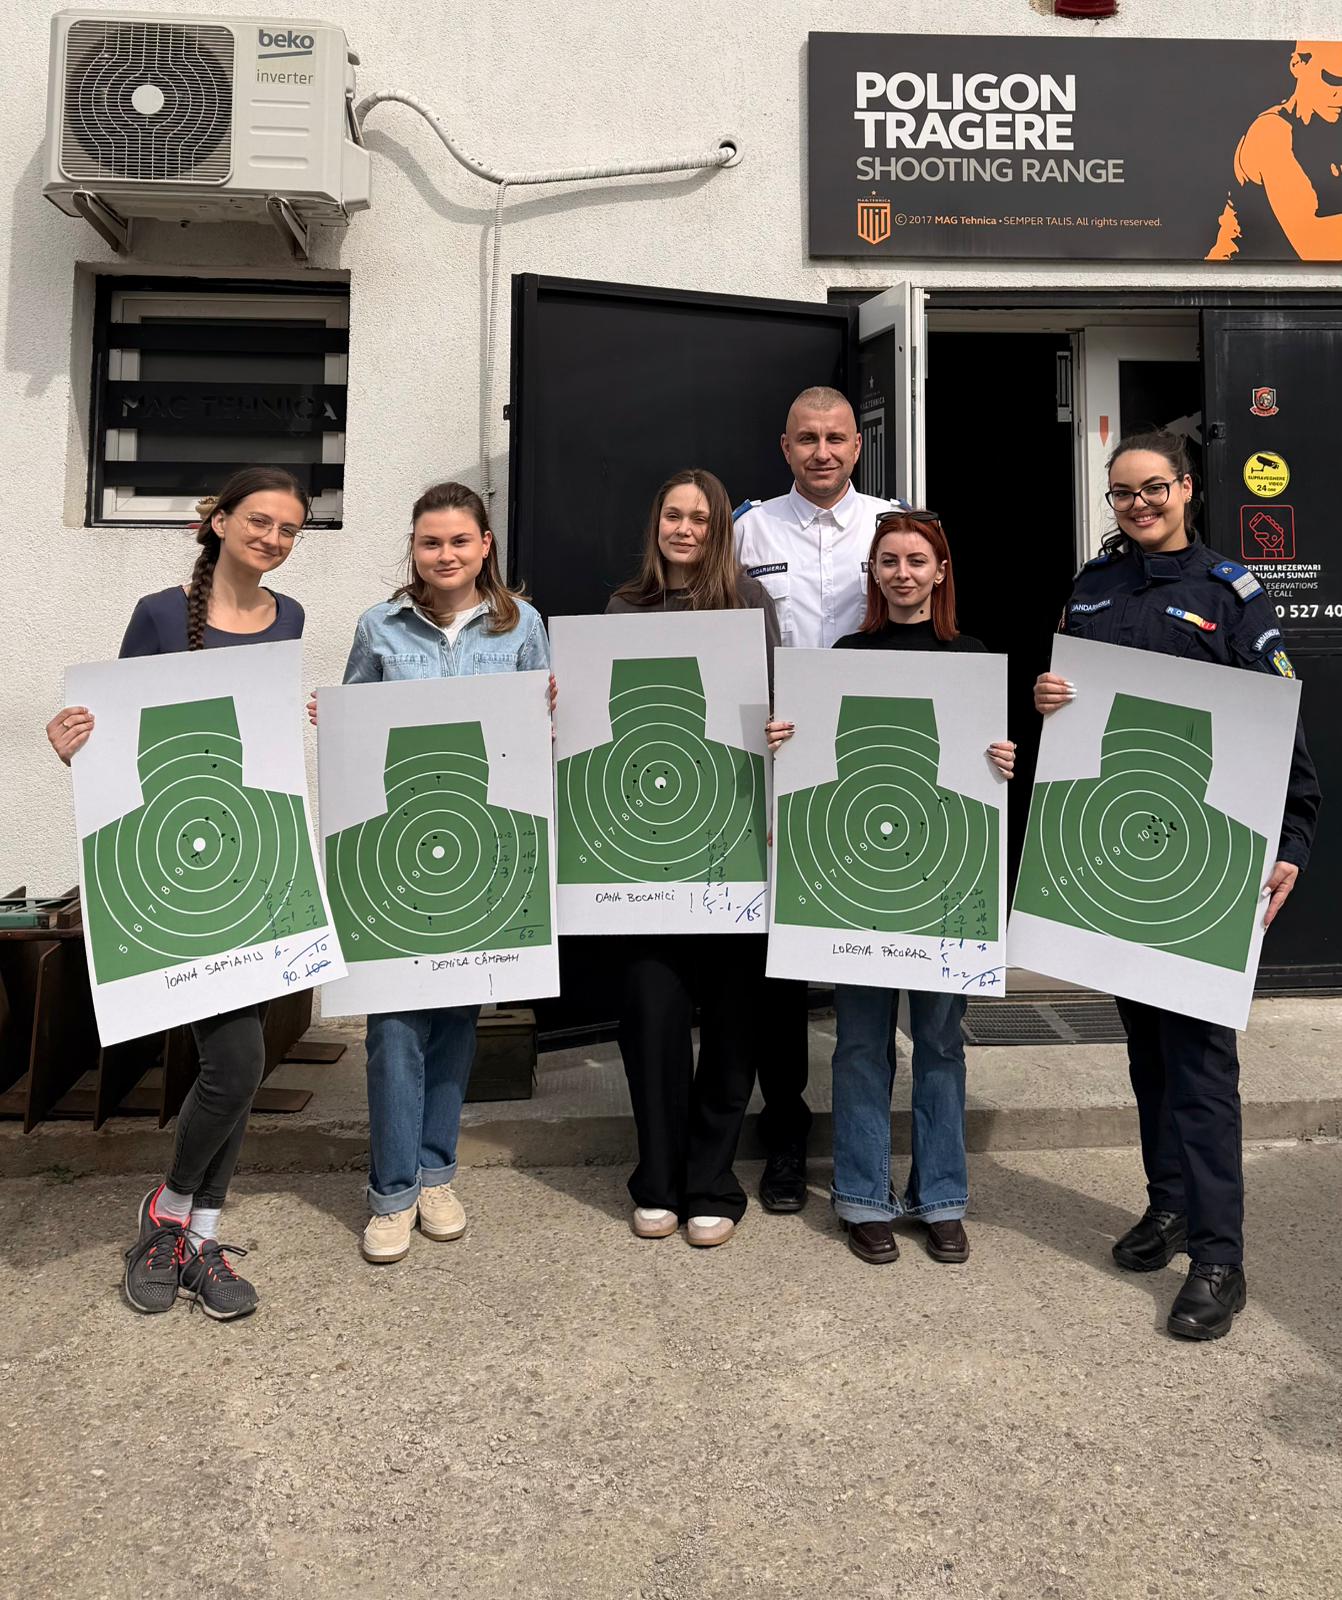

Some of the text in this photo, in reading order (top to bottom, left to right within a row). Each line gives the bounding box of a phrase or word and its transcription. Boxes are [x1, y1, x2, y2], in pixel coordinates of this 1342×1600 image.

[258, 29, 315, 49] beko
[256, 69, 314, 85] inverter
[855, 71, 1076, 112] POLIGON
[854, 111, 1074, 151] TRAGERE
[856, 156, 1125, 183] SHOOTING RANGE
[908, 215, 932, 224] 2017
[934, 216, 958, 225] MAG
[960, 215, 997, 225] Tehnica
[1003, 216, 1043, 226] SEMPER
[1045, 216, 1074, 226] TALIS.
[1076, 216, 1088, 226] All
[1090, 216, 1118, 228] rights
[1119, 216, 1162, 227] reserved.
[1274, 590, 1293, 598] CALL
[1290, 605, 1319, 618] 527
[635, 798, 645, 808] 9
[621, 812, 630, 821] 8
[608, 826, 617, 836] 7
[1137, 829, 1150, 842] 10
[594, 839, 602, 849] 6
[859, 842, 868, 851] 9
[1112, 846, 1121, 856] 9
[579, 854, 587, 864] 5
[844, 855, 853, 865] 8
[1094, 856, 1103, 866] 8
[175, 867, 184, 876] 9
[411, 870, 421, 879] 9
[829, 868, 839, 878] 7
[1077, 866, 1085, 877] 7
[1060, 875, 1068, 886] 6
[161, 886, 170, 894] 8
[396, 885, 406, 894] 8
[814, 881, 823, 891] 6
[1041, 886, 1049, 897] 5
[382, 900, 391, 910] 7
[798, 895, 807, 905] 5
[147, 904, 157, 914] 7
[367, 914, 376, 924] 6
[133, 923, 143, 933] 6
[350, 931, 360, 941] 5
[118, 944, 128, 954] 5
